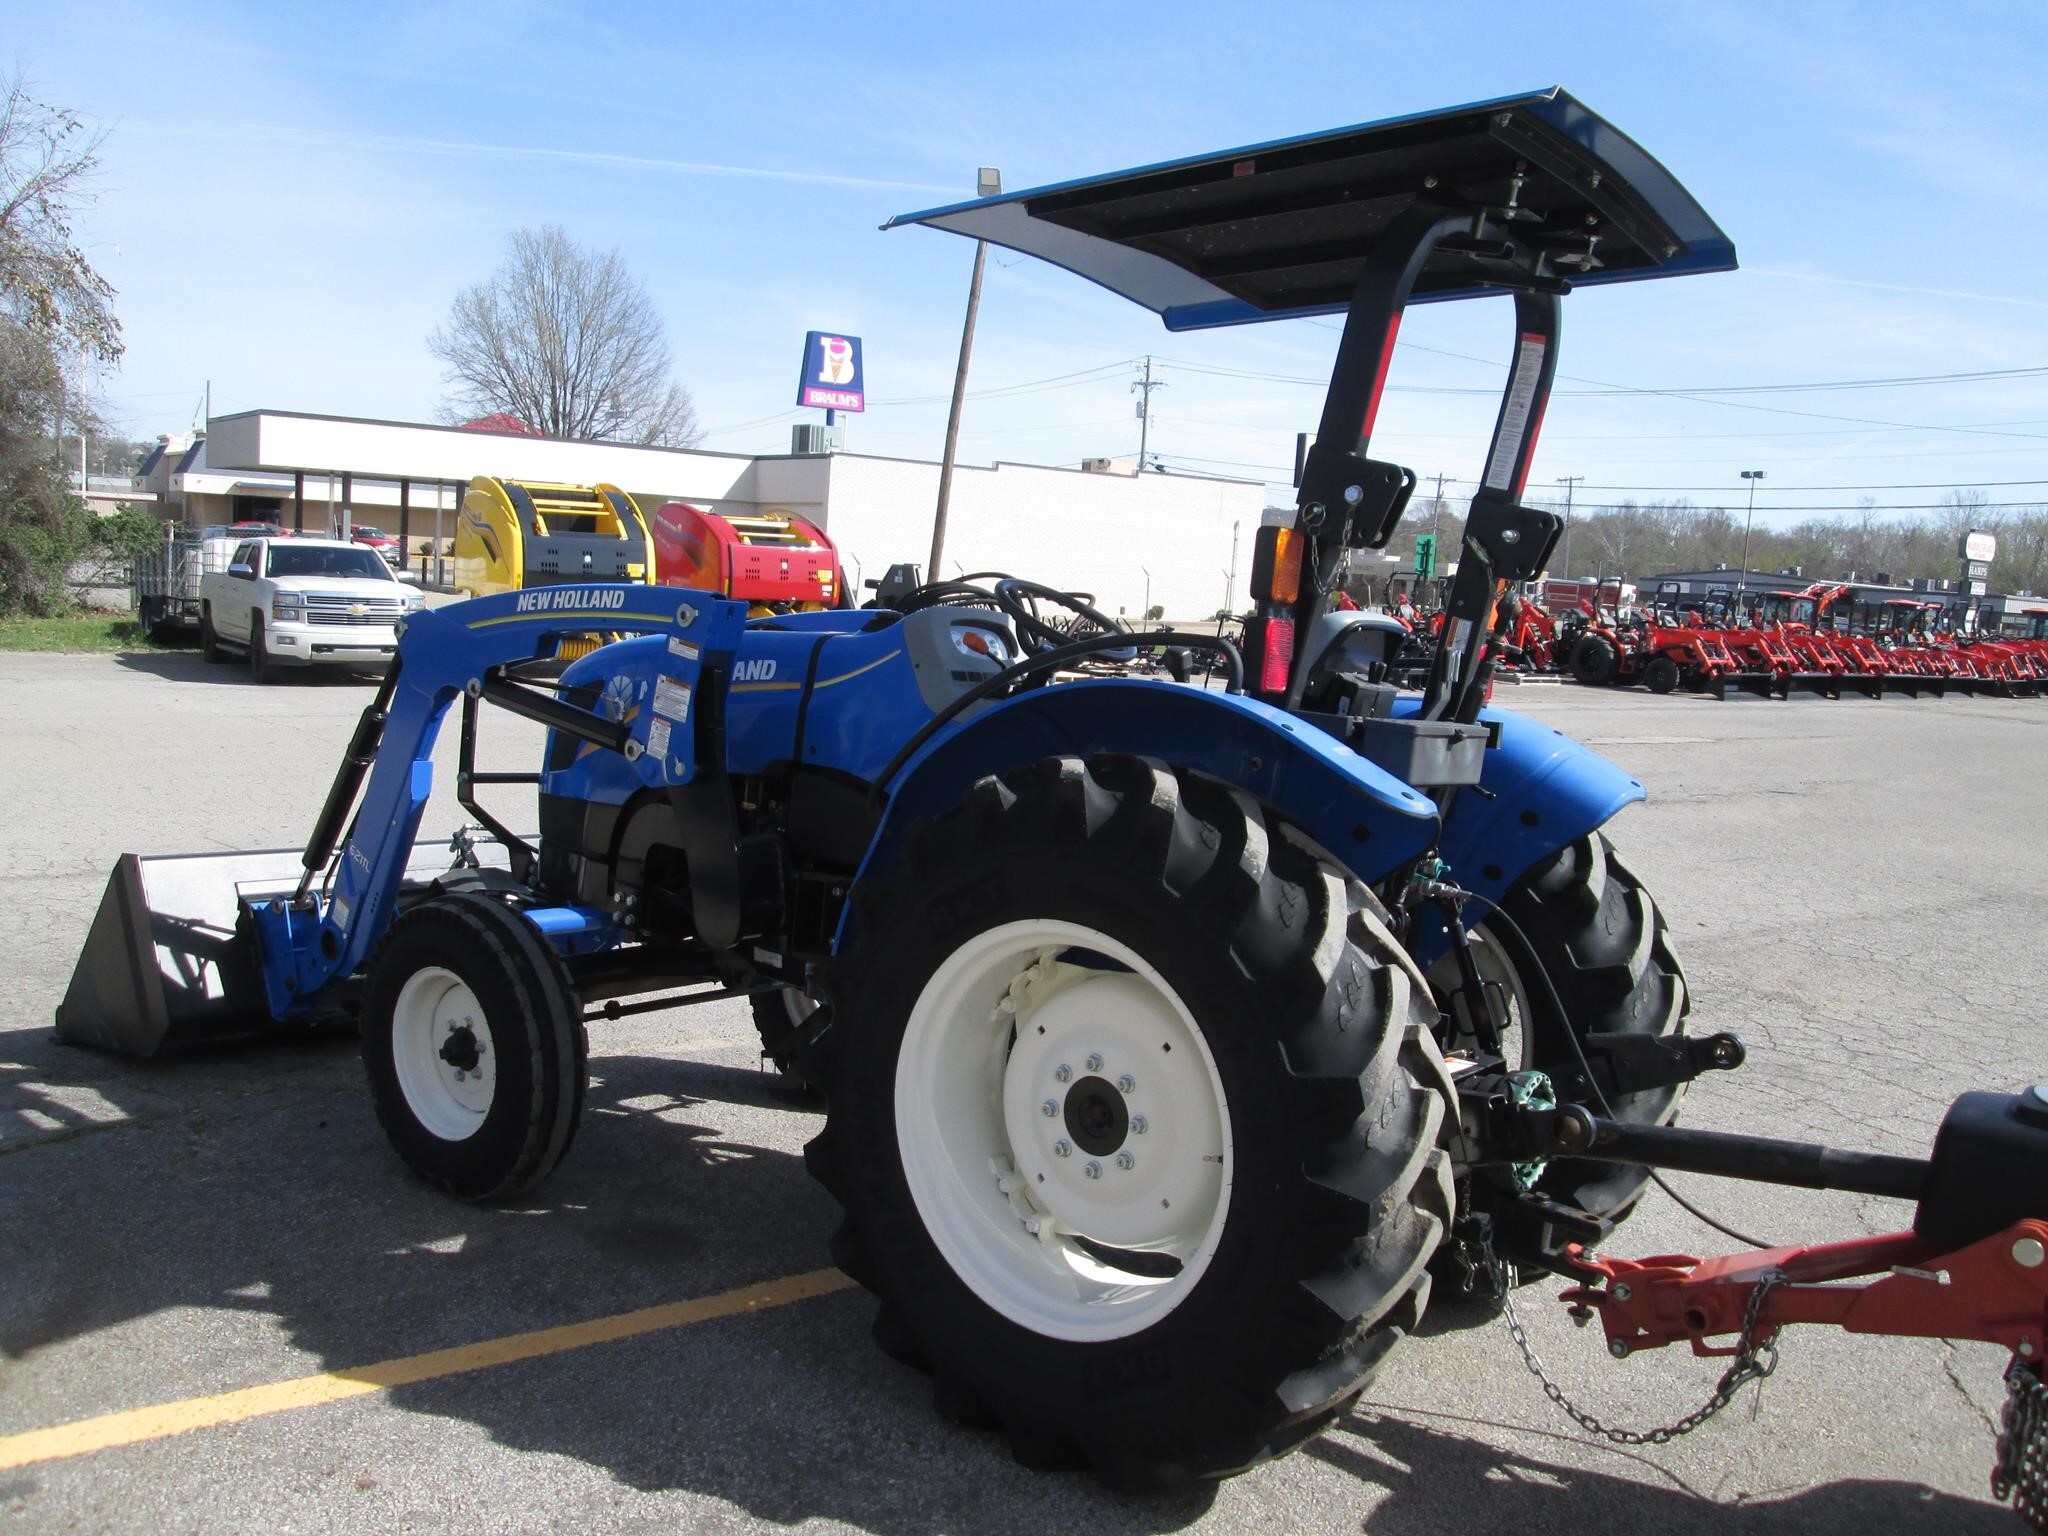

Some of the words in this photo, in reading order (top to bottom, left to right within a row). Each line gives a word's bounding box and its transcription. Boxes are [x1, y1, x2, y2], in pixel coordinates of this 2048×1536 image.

[819, 336, 855, 384] B
[516, 592, 551, 612] NEW
[553, 590, 625, 608] HOLLAND
